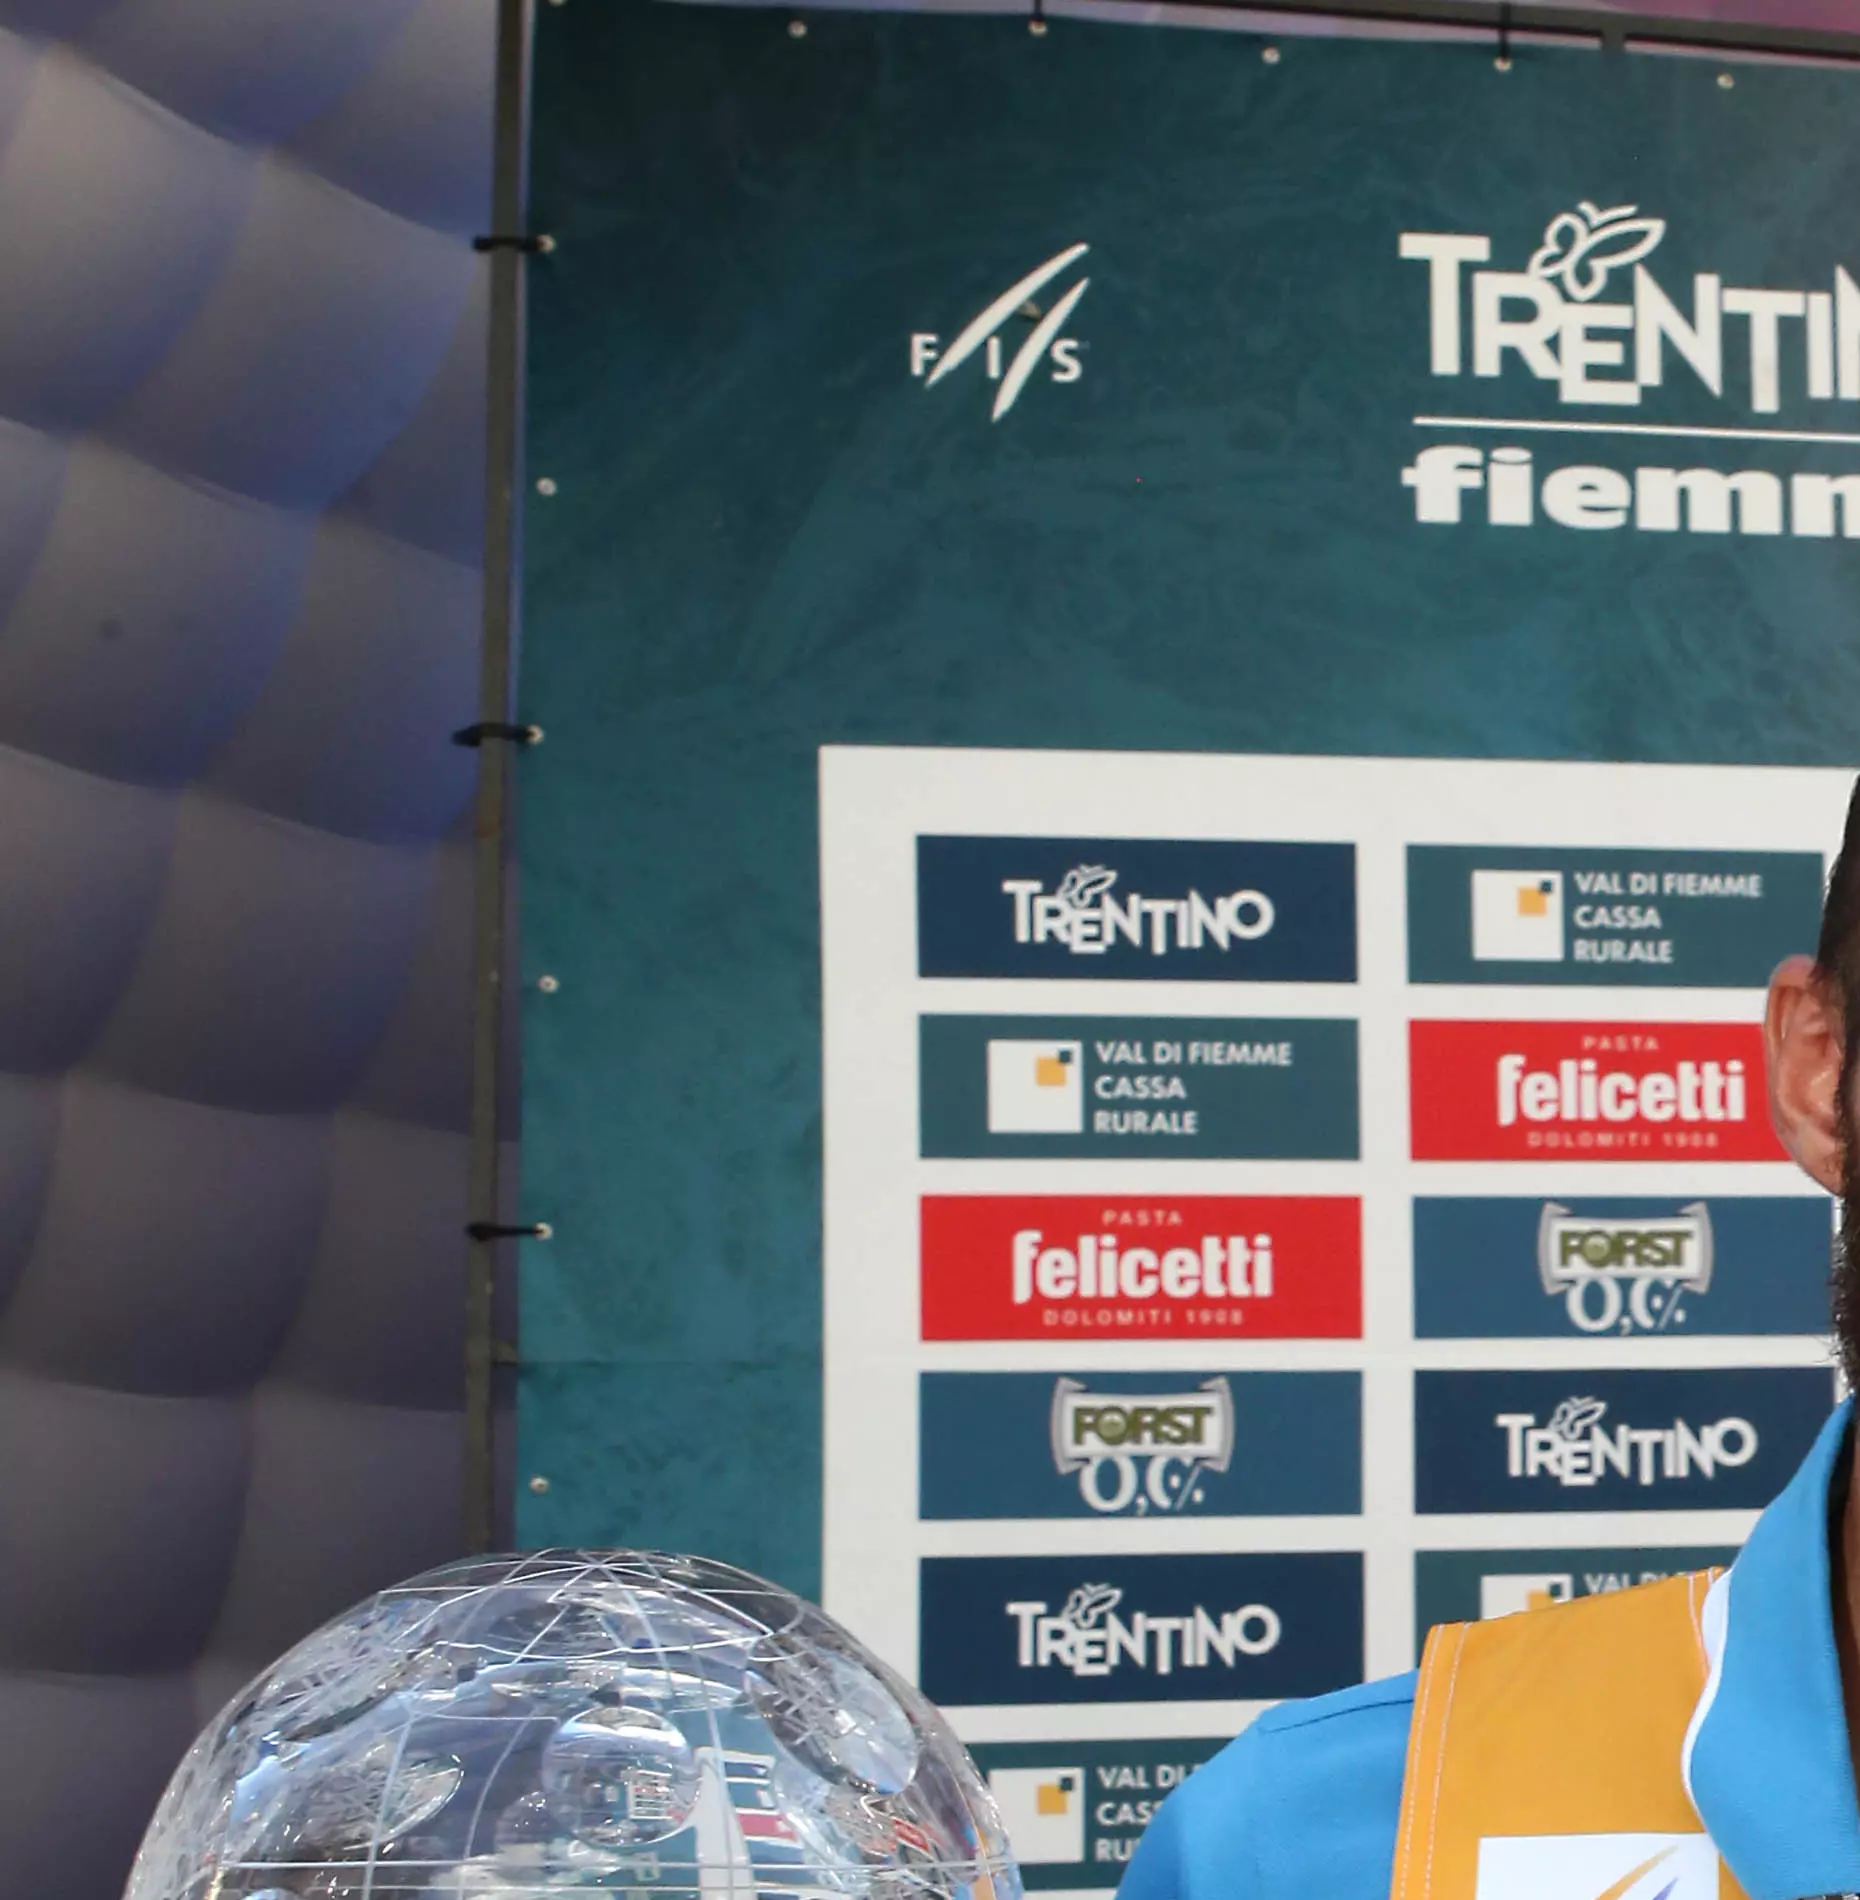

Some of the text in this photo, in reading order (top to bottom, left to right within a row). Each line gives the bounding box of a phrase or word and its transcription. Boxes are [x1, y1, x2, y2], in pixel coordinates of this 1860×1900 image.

[1574, 872, 1763, 898] VAL DI FIEMME
[1002, 879, 1275, 954] TRENTINO
[1573, 905, 1662, 929] CASSA
[1573, 939, 1674, 963] RURALE
[1095, 1041, 1293, 1067] VAL DI FIEMME
[1094, 1076, 1187, 1100] CASSA
[1497, 1054, 1746, 1127] felicetti
[1094, 1110, 1198, 1134] RURALE
[1559, 1229, 1694, 1268] FORST
[1012, 1230, 1274, 1304] felicetti
[1073, 1402, 1216, 1447] FORST
[1495, 1412, 1757, 1486] TRENTINO
[1007, 1600, 1280, 1676] TRENTINO
[1096, 1765, 1150, 1789] VAL
[1095, 1801, 1162, 1825] CAS
